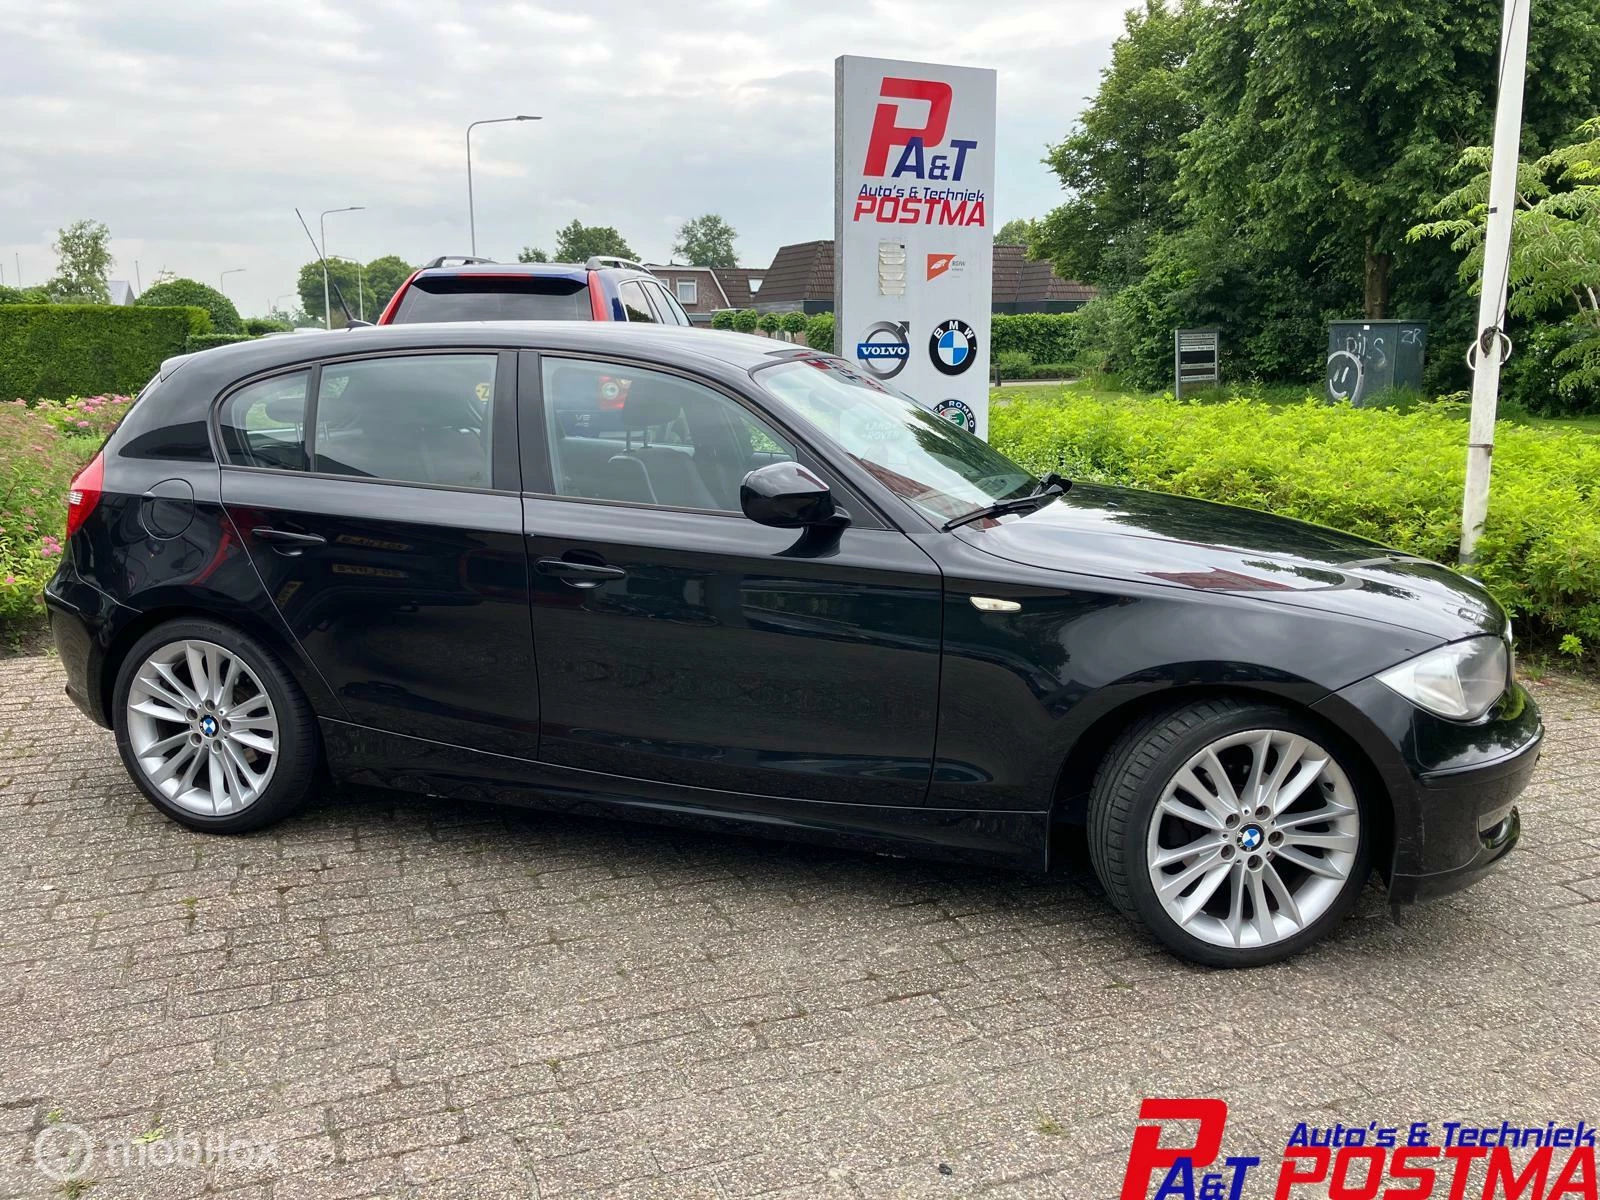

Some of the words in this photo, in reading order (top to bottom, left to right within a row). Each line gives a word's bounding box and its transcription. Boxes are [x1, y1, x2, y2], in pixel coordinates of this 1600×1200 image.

[859, 183, 905, 198] Auto's
[909, 186, 918, 199] &
[923, 186, 985, 202] Techniek
[853, 196, 985, 227] POSTMA
[934, 321, 974, 339] BMW
[860, 346, 907, 356] VOLVO
[948, 400, 975, 428] ROMEO
